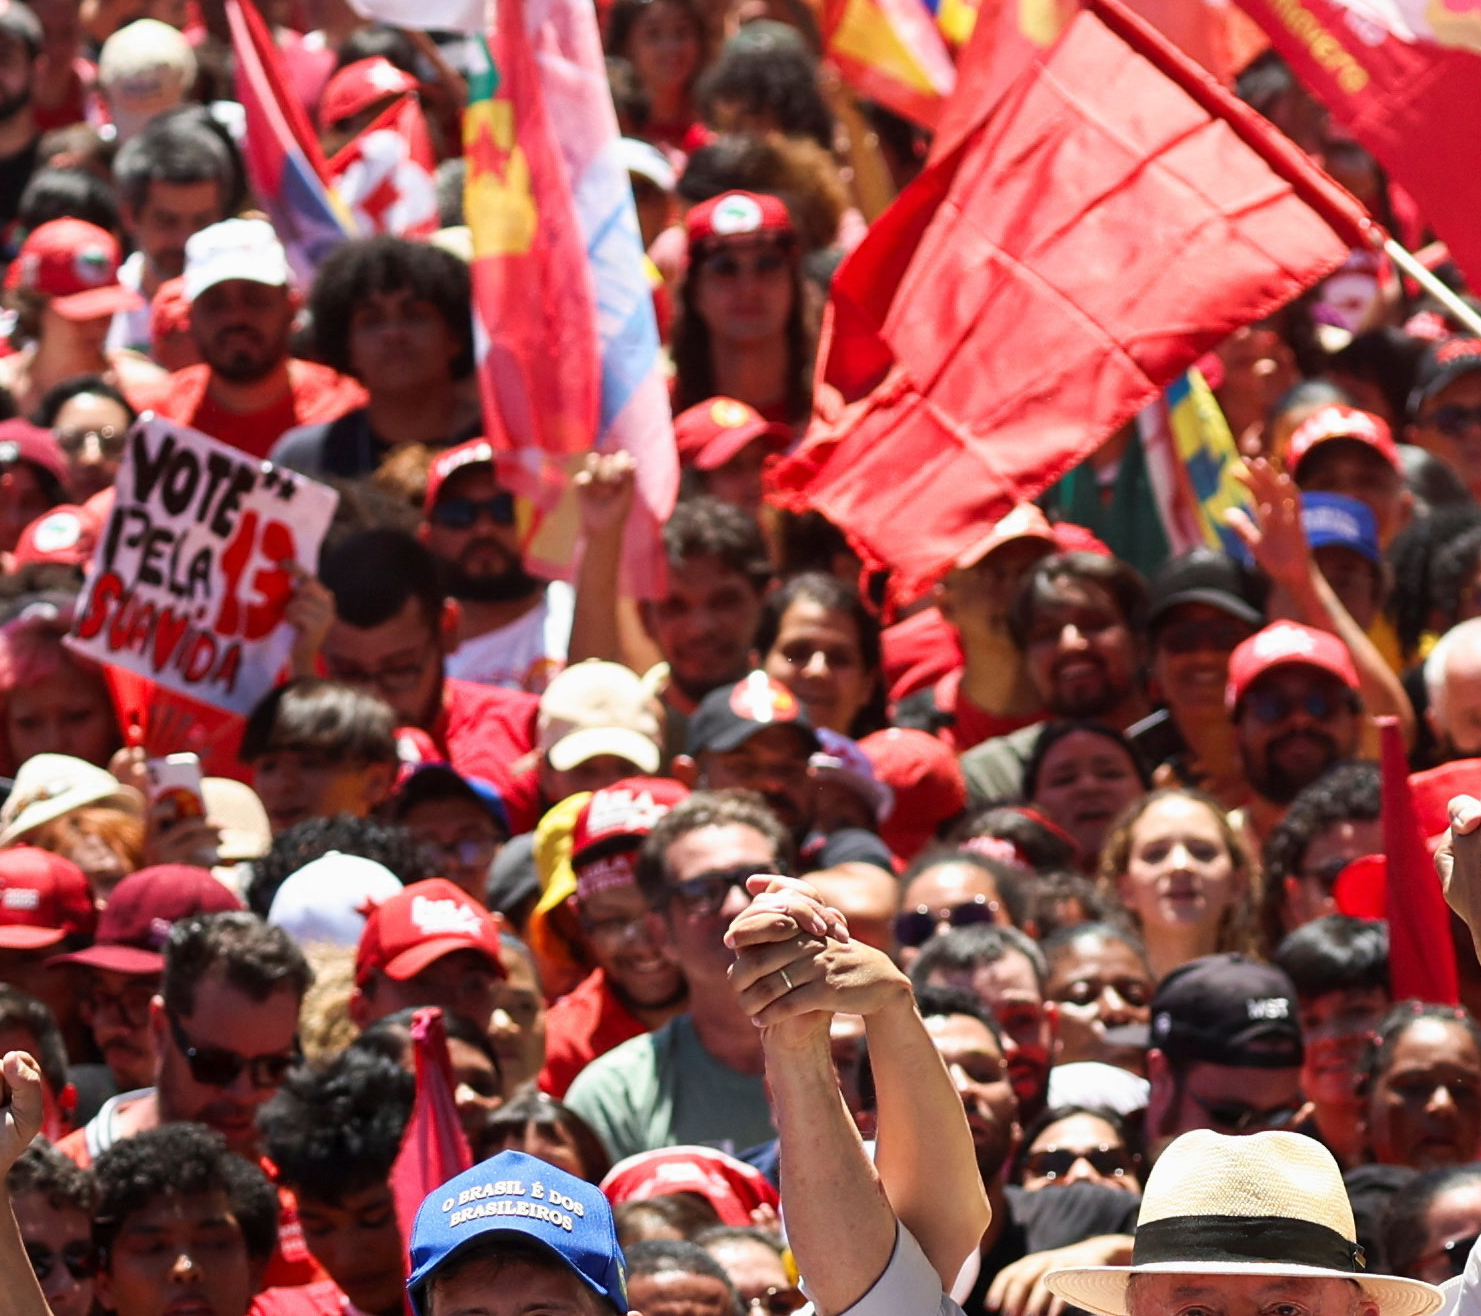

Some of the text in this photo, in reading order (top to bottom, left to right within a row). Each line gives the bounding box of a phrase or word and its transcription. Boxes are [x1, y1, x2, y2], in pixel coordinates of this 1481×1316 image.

[132, 431, 256, 539] VOTE
[103, 505, 218, 600] PELA
[215, 508, 298, 642] 13
[448, 1202, 573, 1232] BRASILEIROS
[457, 1179, 527, 1206] BRASIL
[547, 1190, 585, 1217] DOS
